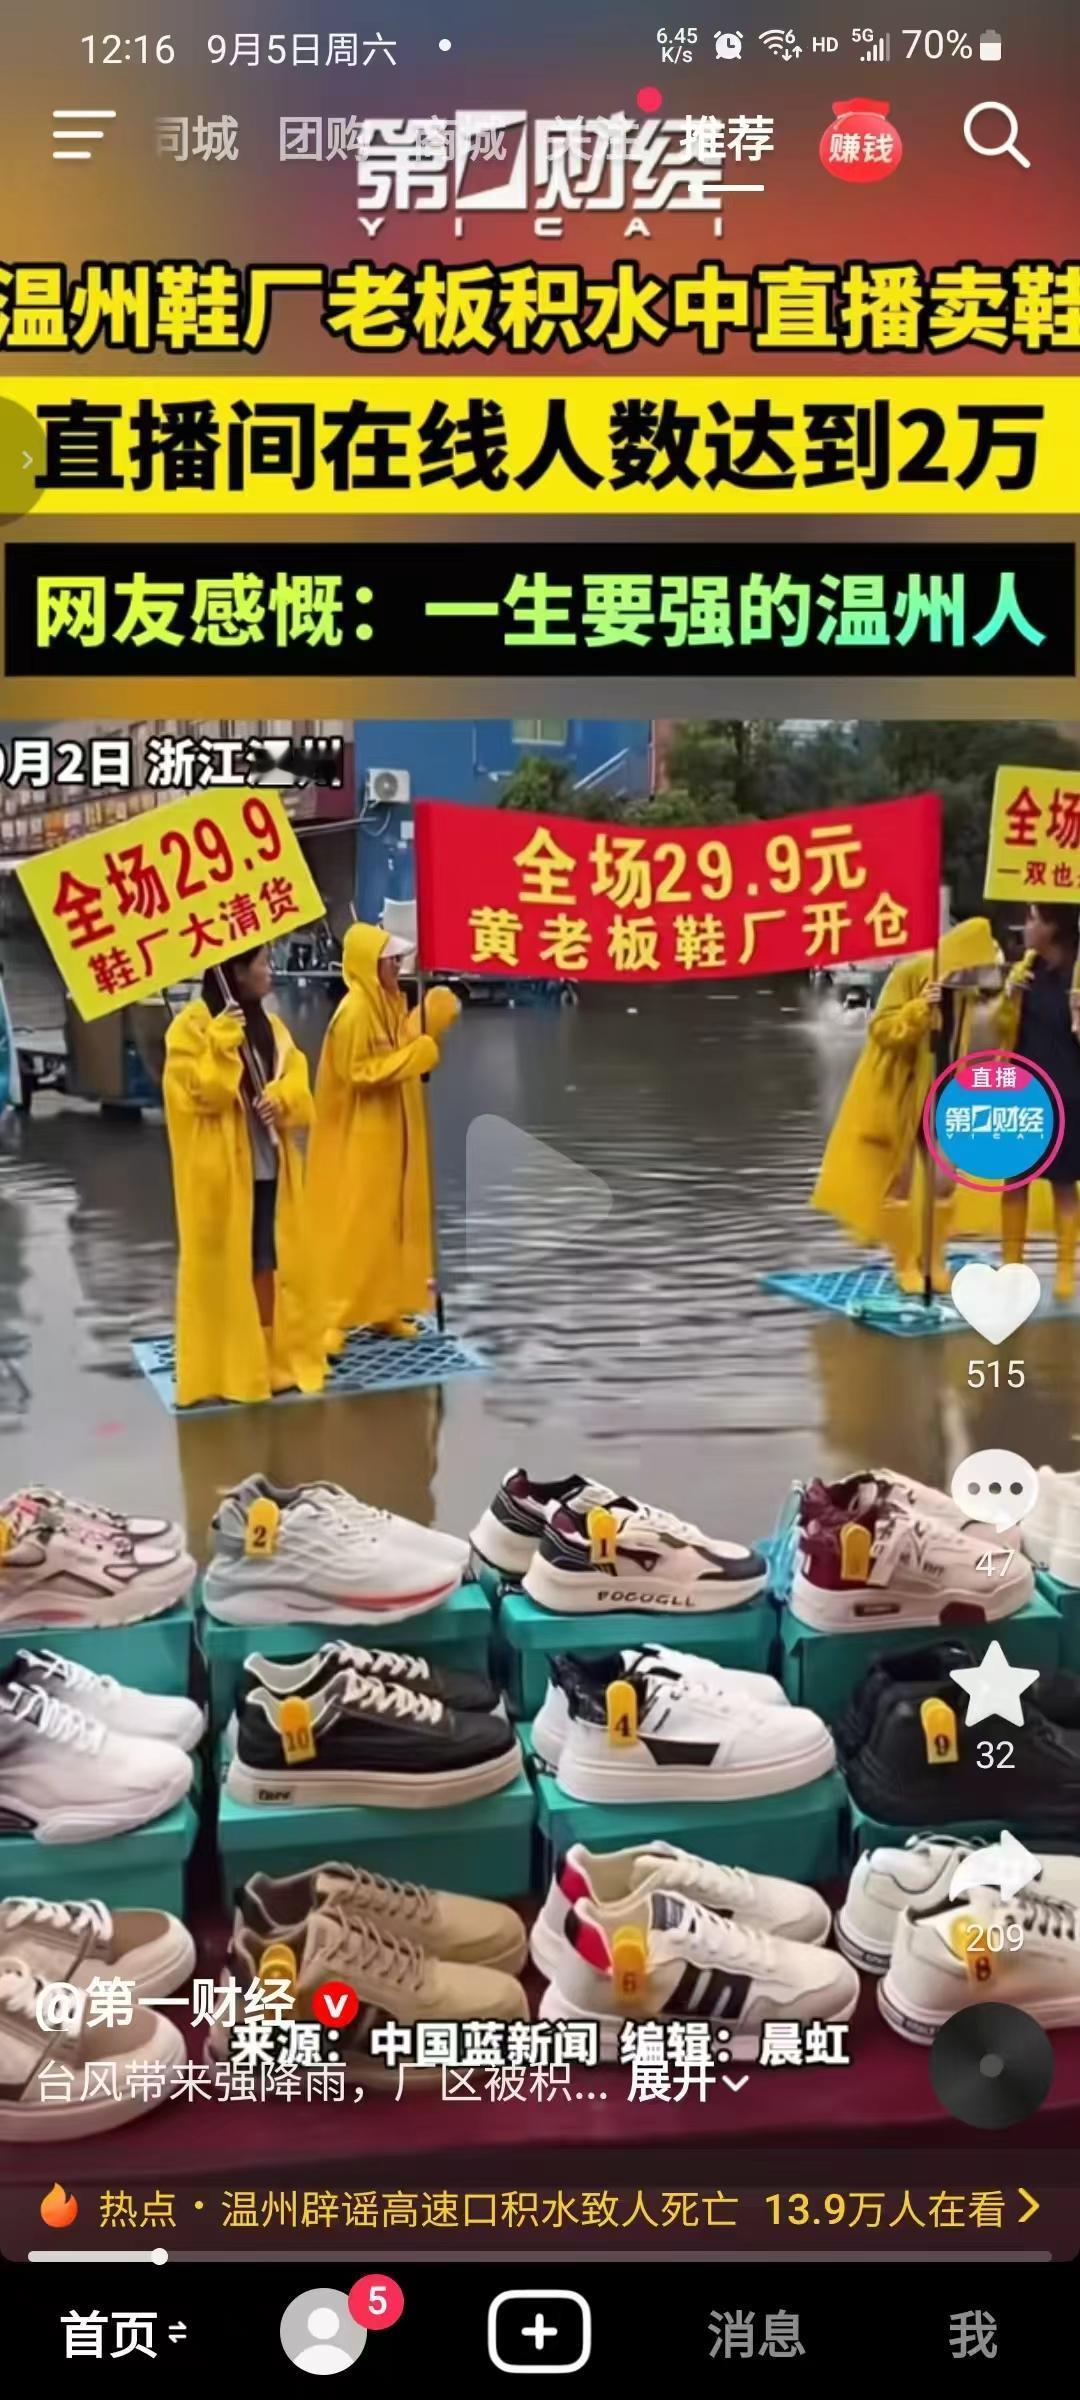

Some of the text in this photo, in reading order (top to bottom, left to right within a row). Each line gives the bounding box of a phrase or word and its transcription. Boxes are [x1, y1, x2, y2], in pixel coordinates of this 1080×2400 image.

[53, 797, 283, 950] 全场29.9
[513, 824, 868, 909] 全场29.9元
[88, 877, 300, 995] 鞋厂大清货
[469, 891, 909, 971] 黄老板鞋厂开仓
[253, 1525, 267, 1548] 2
[285, 1728, 309, 1752] 10
[615, 1713, 632, 1737] 4
[935, 1733, 950, 1756] 9
